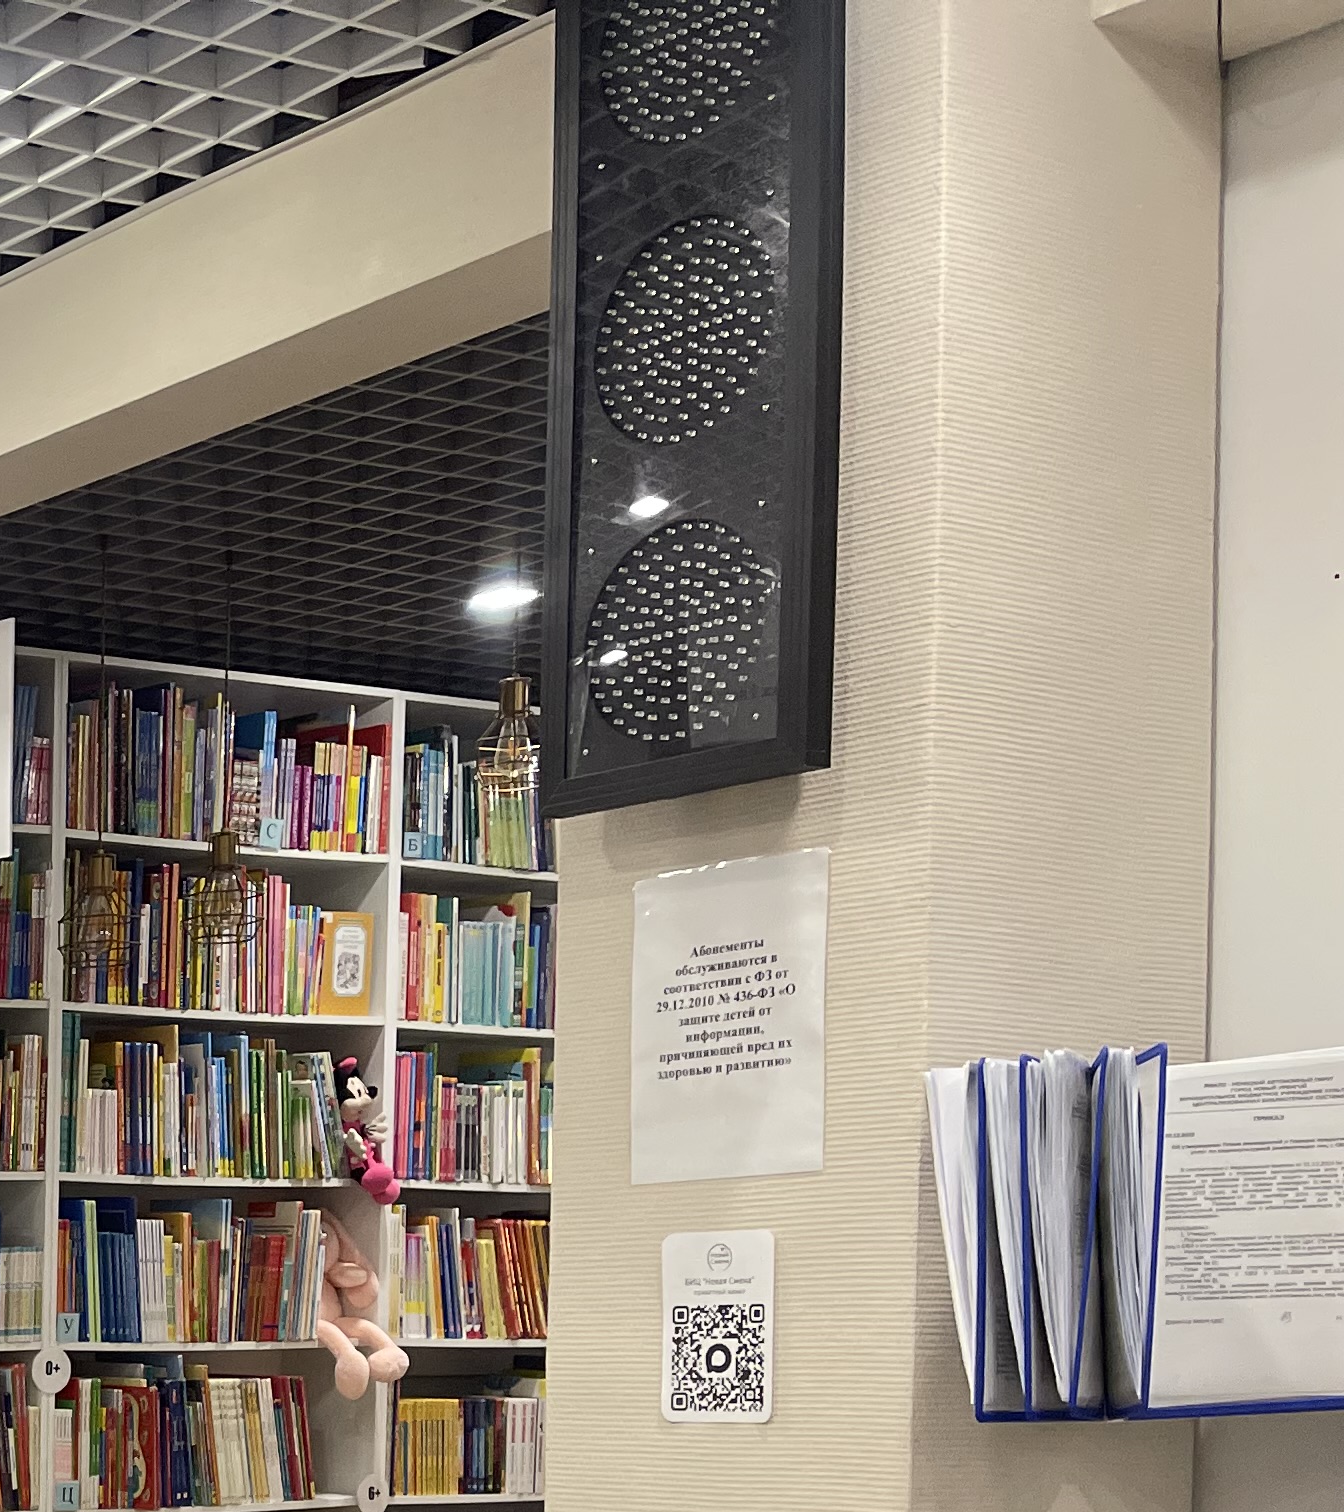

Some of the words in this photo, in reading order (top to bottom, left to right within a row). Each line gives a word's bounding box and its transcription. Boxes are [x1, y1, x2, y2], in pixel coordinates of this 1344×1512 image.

[266, 823, 278, 839] С
[408, 838, 418, 851] Б
[689, 938, 764, 958] Абонементы
[675, 955, 767, 977] обслуживаются
[771, 954, 778, 963] в
[663, 977, 742, 995] соответствии
[745, 975, 751, 984] с
[754, 969, 772, 982] ФЗ
[775, 969, 789, 980] от
[656, 995, 714, 1013] 29.12.2010
[733, 986, 775, 1002] 436-ФЗ
[779, 983, 796, 995] «О
[678, 1013, 720, 1027] защите
[723, 1006, 755, 1022] детей
[759, 1006, 772, 1016] от
[659, 1043, 744, 1065] причиняющей
[747, 1041, 774, 1054] вред
[778, 1038, 793, 1049] их
[657, 1064, 712, 1081] здоровью
[715, 1064, 722, 1073] и
[726, 1057, 792, 1075] развитию»
[63, 1317, 75, 1334] У
[45, 1360, 60, 1376] 0+
[62, 1487, 74, 1505] Ц
[368, 1486, 381, 1500] 6+
